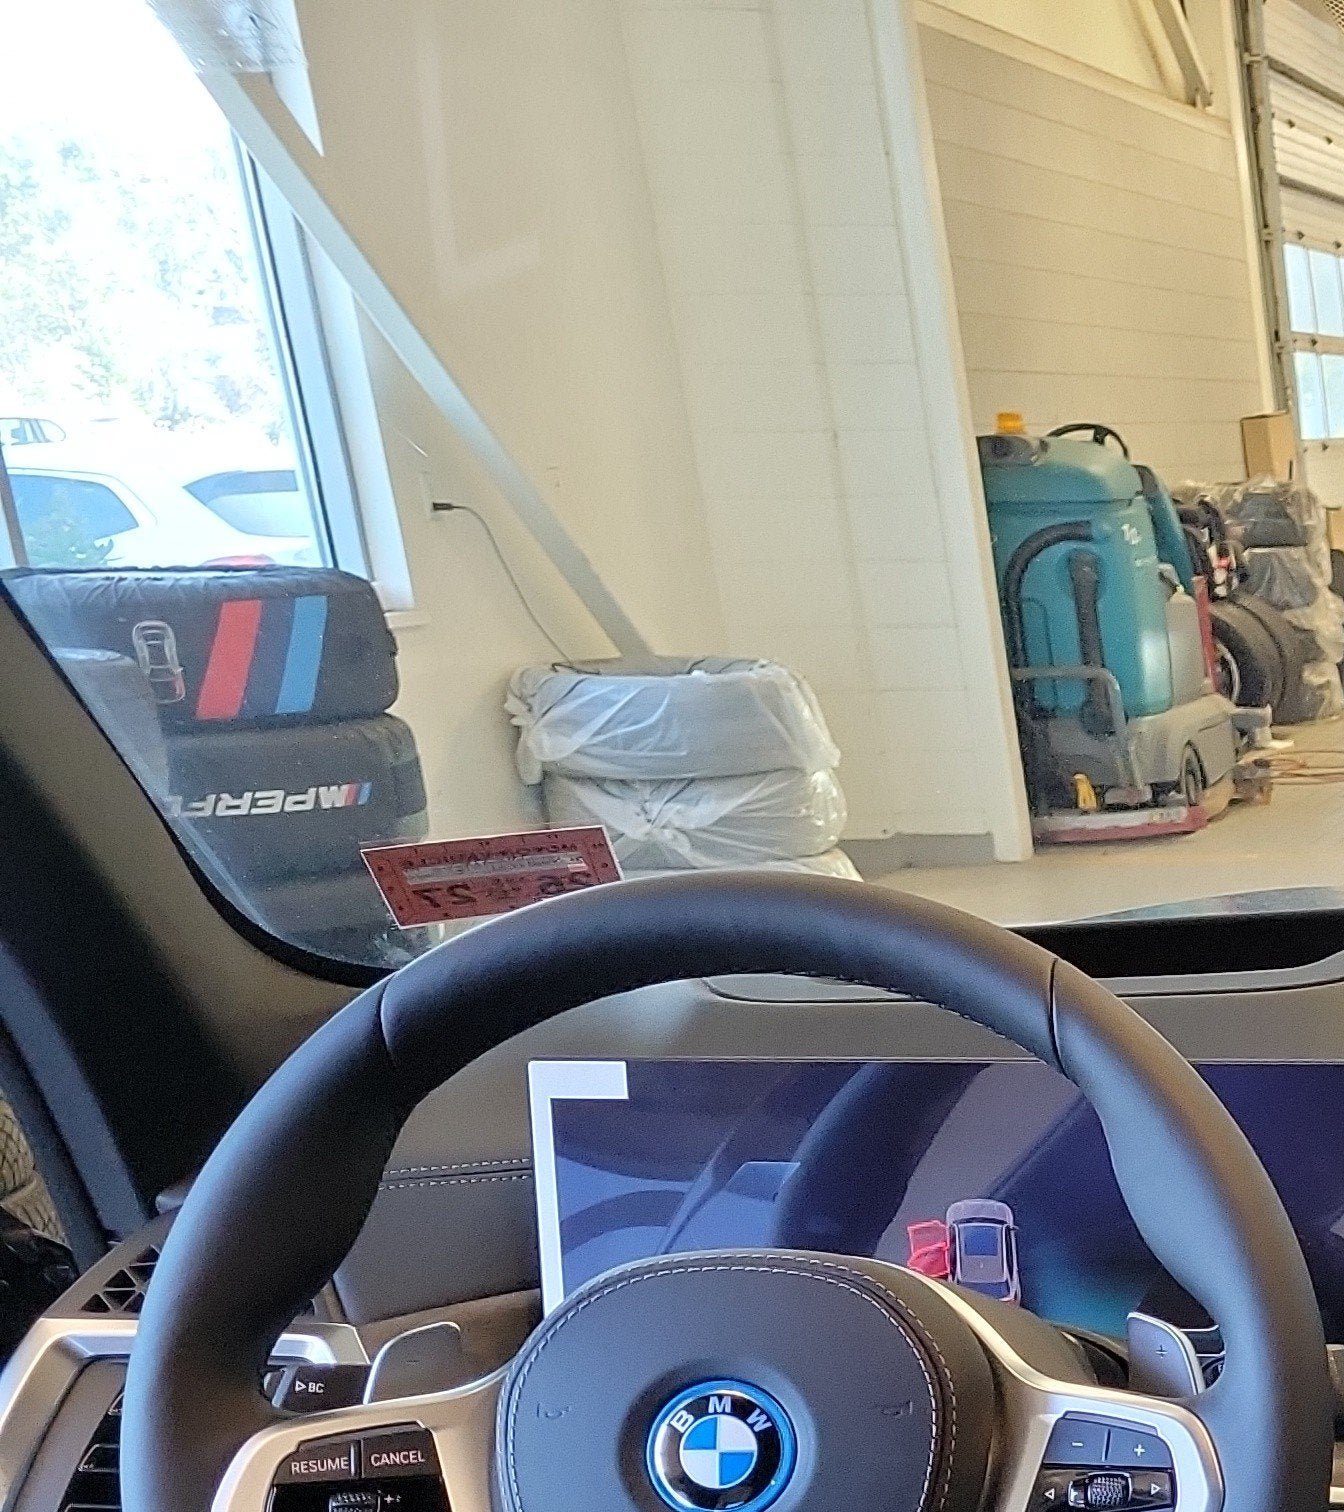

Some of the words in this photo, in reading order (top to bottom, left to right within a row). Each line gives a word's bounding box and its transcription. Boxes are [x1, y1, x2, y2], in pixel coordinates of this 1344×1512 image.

[307, 1383, 325, 1393] BC
[669, 1395, 773, 1434] BMW
[290, 1456, 350, 1475] RESUME
[370, 1450, 426, 1467] CANCEL
